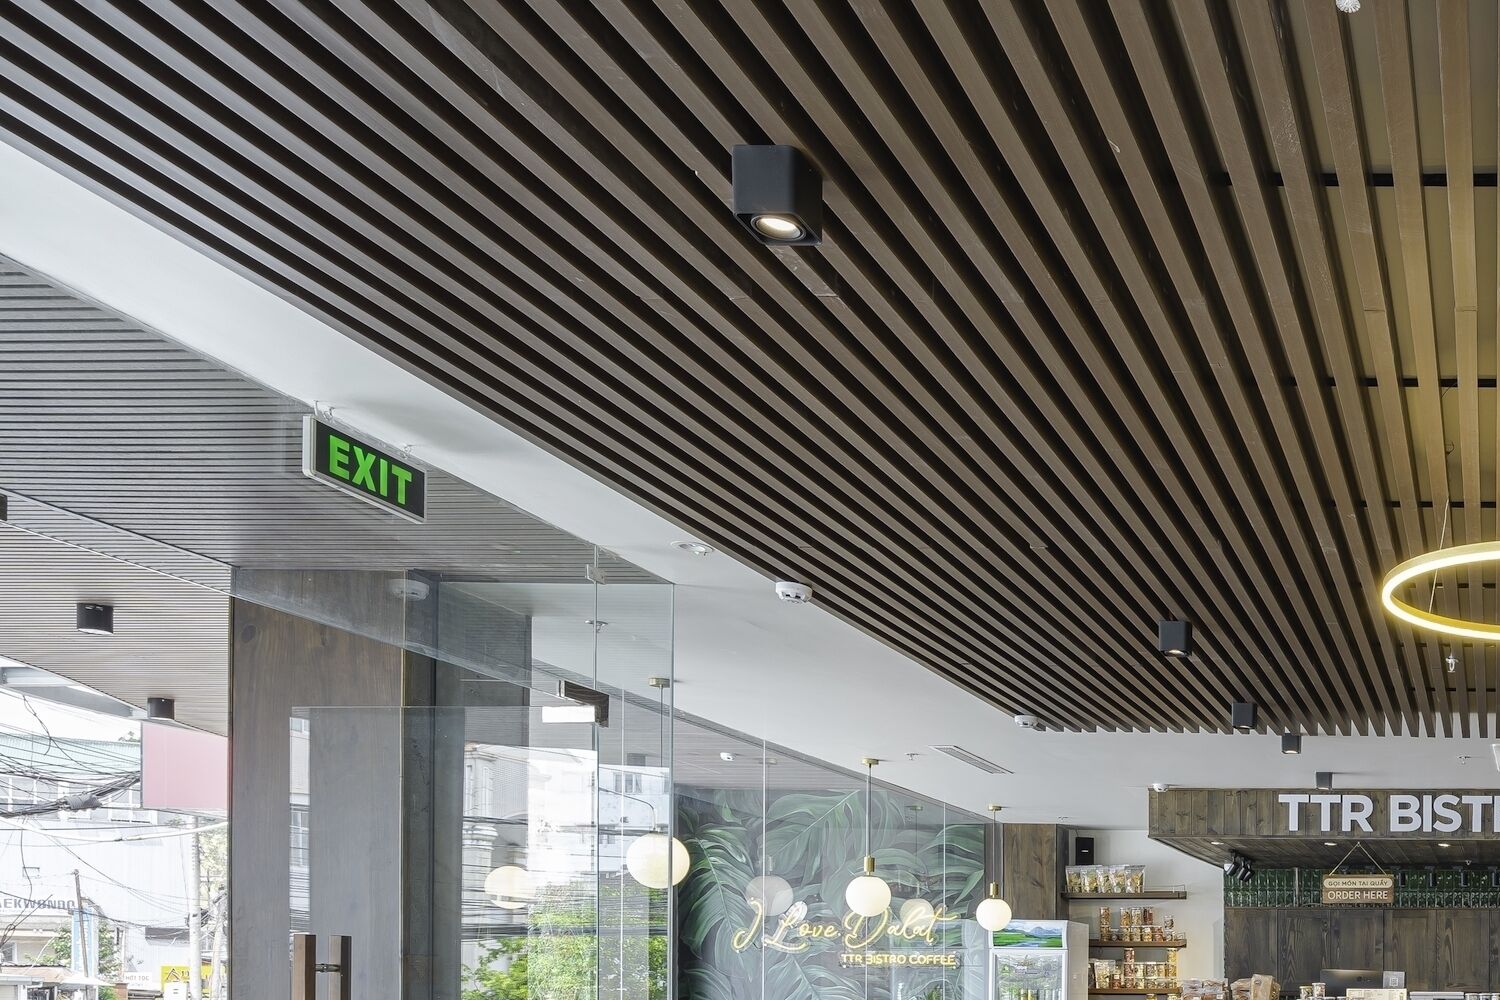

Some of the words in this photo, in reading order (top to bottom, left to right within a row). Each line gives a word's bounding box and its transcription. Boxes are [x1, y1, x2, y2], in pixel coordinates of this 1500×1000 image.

[329, 435, 412, 505] EXIT
[1278, 794, 1374, 832] TTR
[1327, 890, 1361, 900] ORDER
[1363, 890, 1389, 900] HERE
[841, 954, 862, 964] TTR
[865, 953, 906, 965] BISTRO
[908, 953, 956, 966] COFFEE
